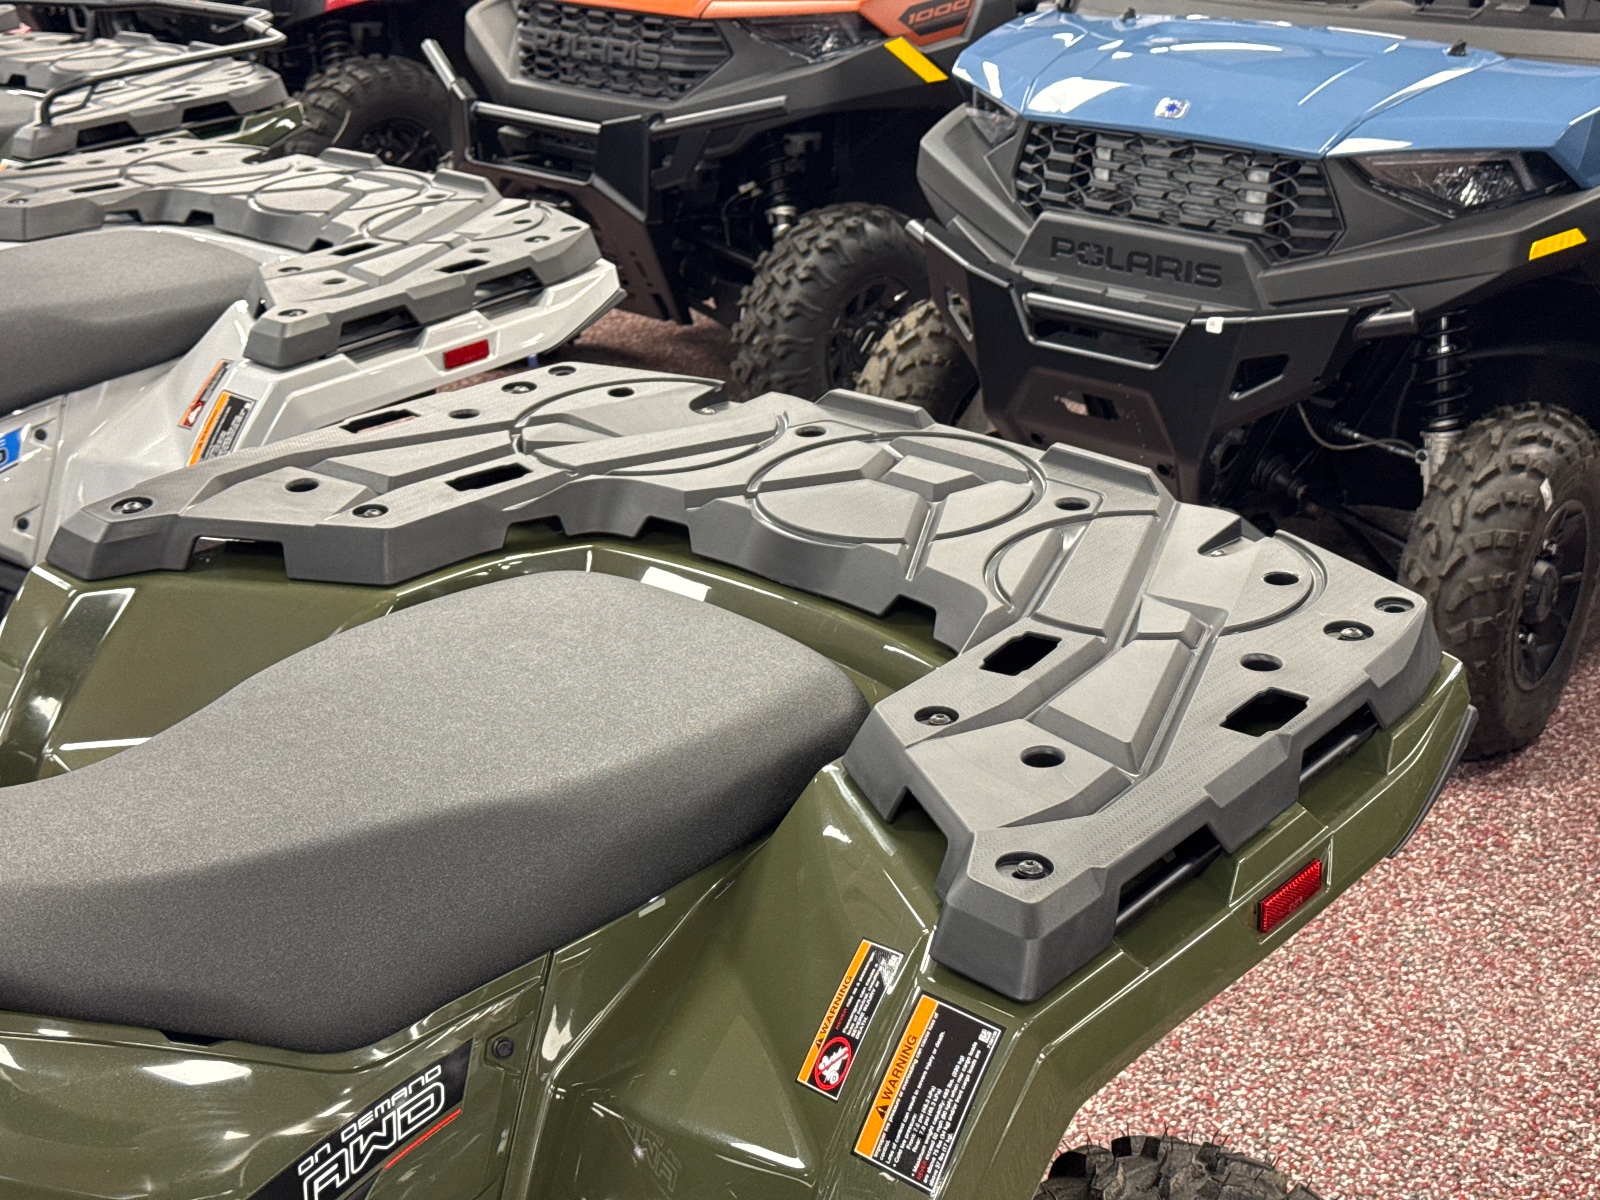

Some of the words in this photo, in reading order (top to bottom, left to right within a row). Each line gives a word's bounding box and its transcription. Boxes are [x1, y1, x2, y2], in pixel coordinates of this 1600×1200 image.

[908, 0, 971, 24] 1000
[531, 27, 661, 69] POLARIS
[1051, 236, 1222, 288] POLARIS
[820, 975, 853, 1036] WARNING
[835, 1007, 849, 1030] NEVER
[850, 1012, 866, 1038] SEVERE
[881, 1033, 918, 1102] WARNING
[297, 1142, 331, 1177] ON
[341, 1064, 442, 1143] DEMAND
[885, 1149, 895, 1164] Loss
[894, 1122, 906, 1143] control
[903, 1112, 911, 1123] can
[907, 1095, 918, 1112] result
[917, 1071, 929, 1090] severe
[925, 1055, 935, 1071] injury
[303, 1081, 445, 1200] AWD
